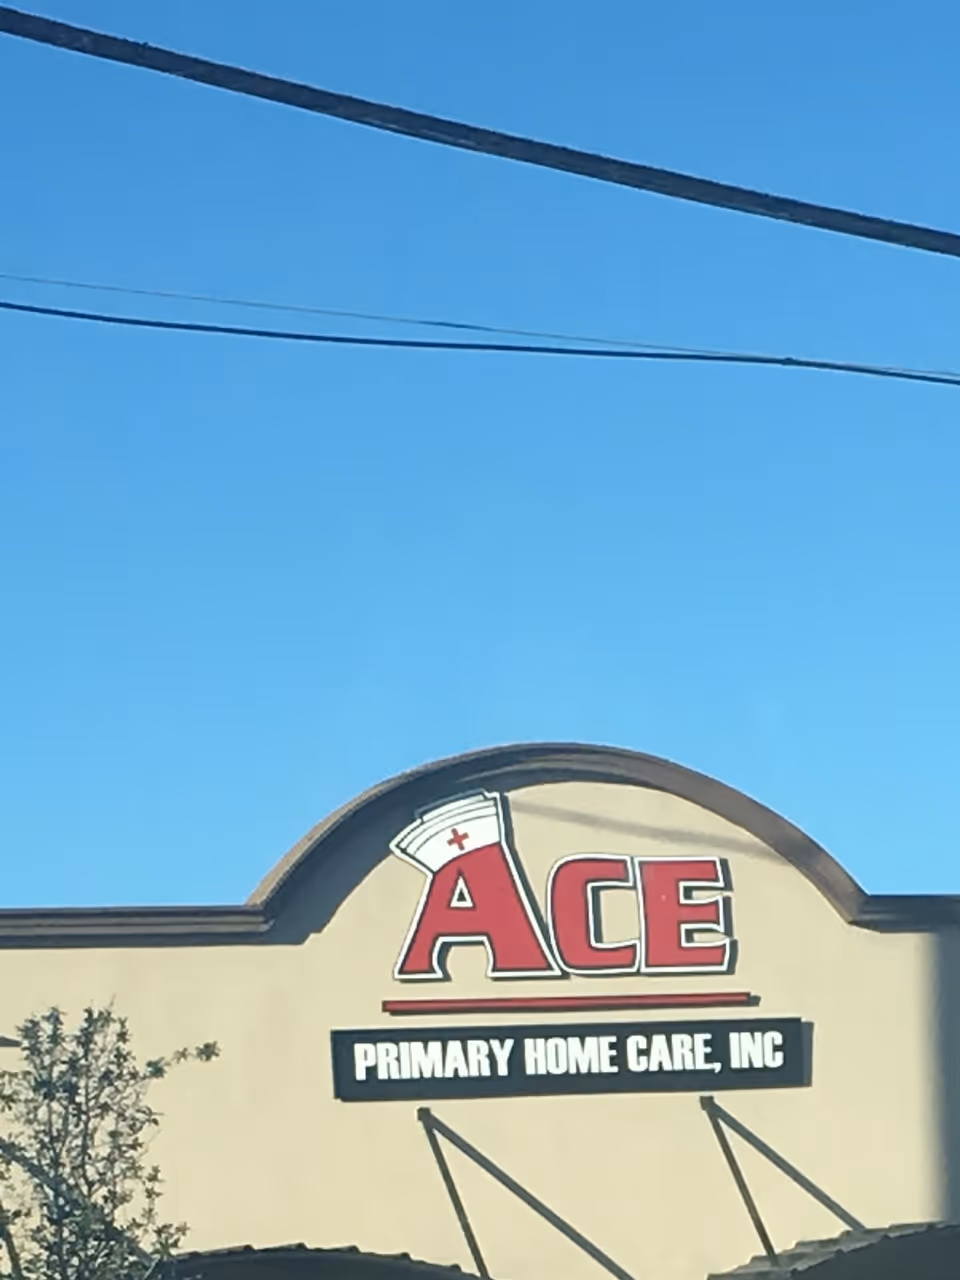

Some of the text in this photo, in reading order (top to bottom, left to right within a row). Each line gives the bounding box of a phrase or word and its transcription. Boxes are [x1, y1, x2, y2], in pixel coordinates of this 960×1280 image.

[391, 792, 731, 979] ACE
[353, 1031, 784, 1081] PRIMARY HOME CARE, INC
